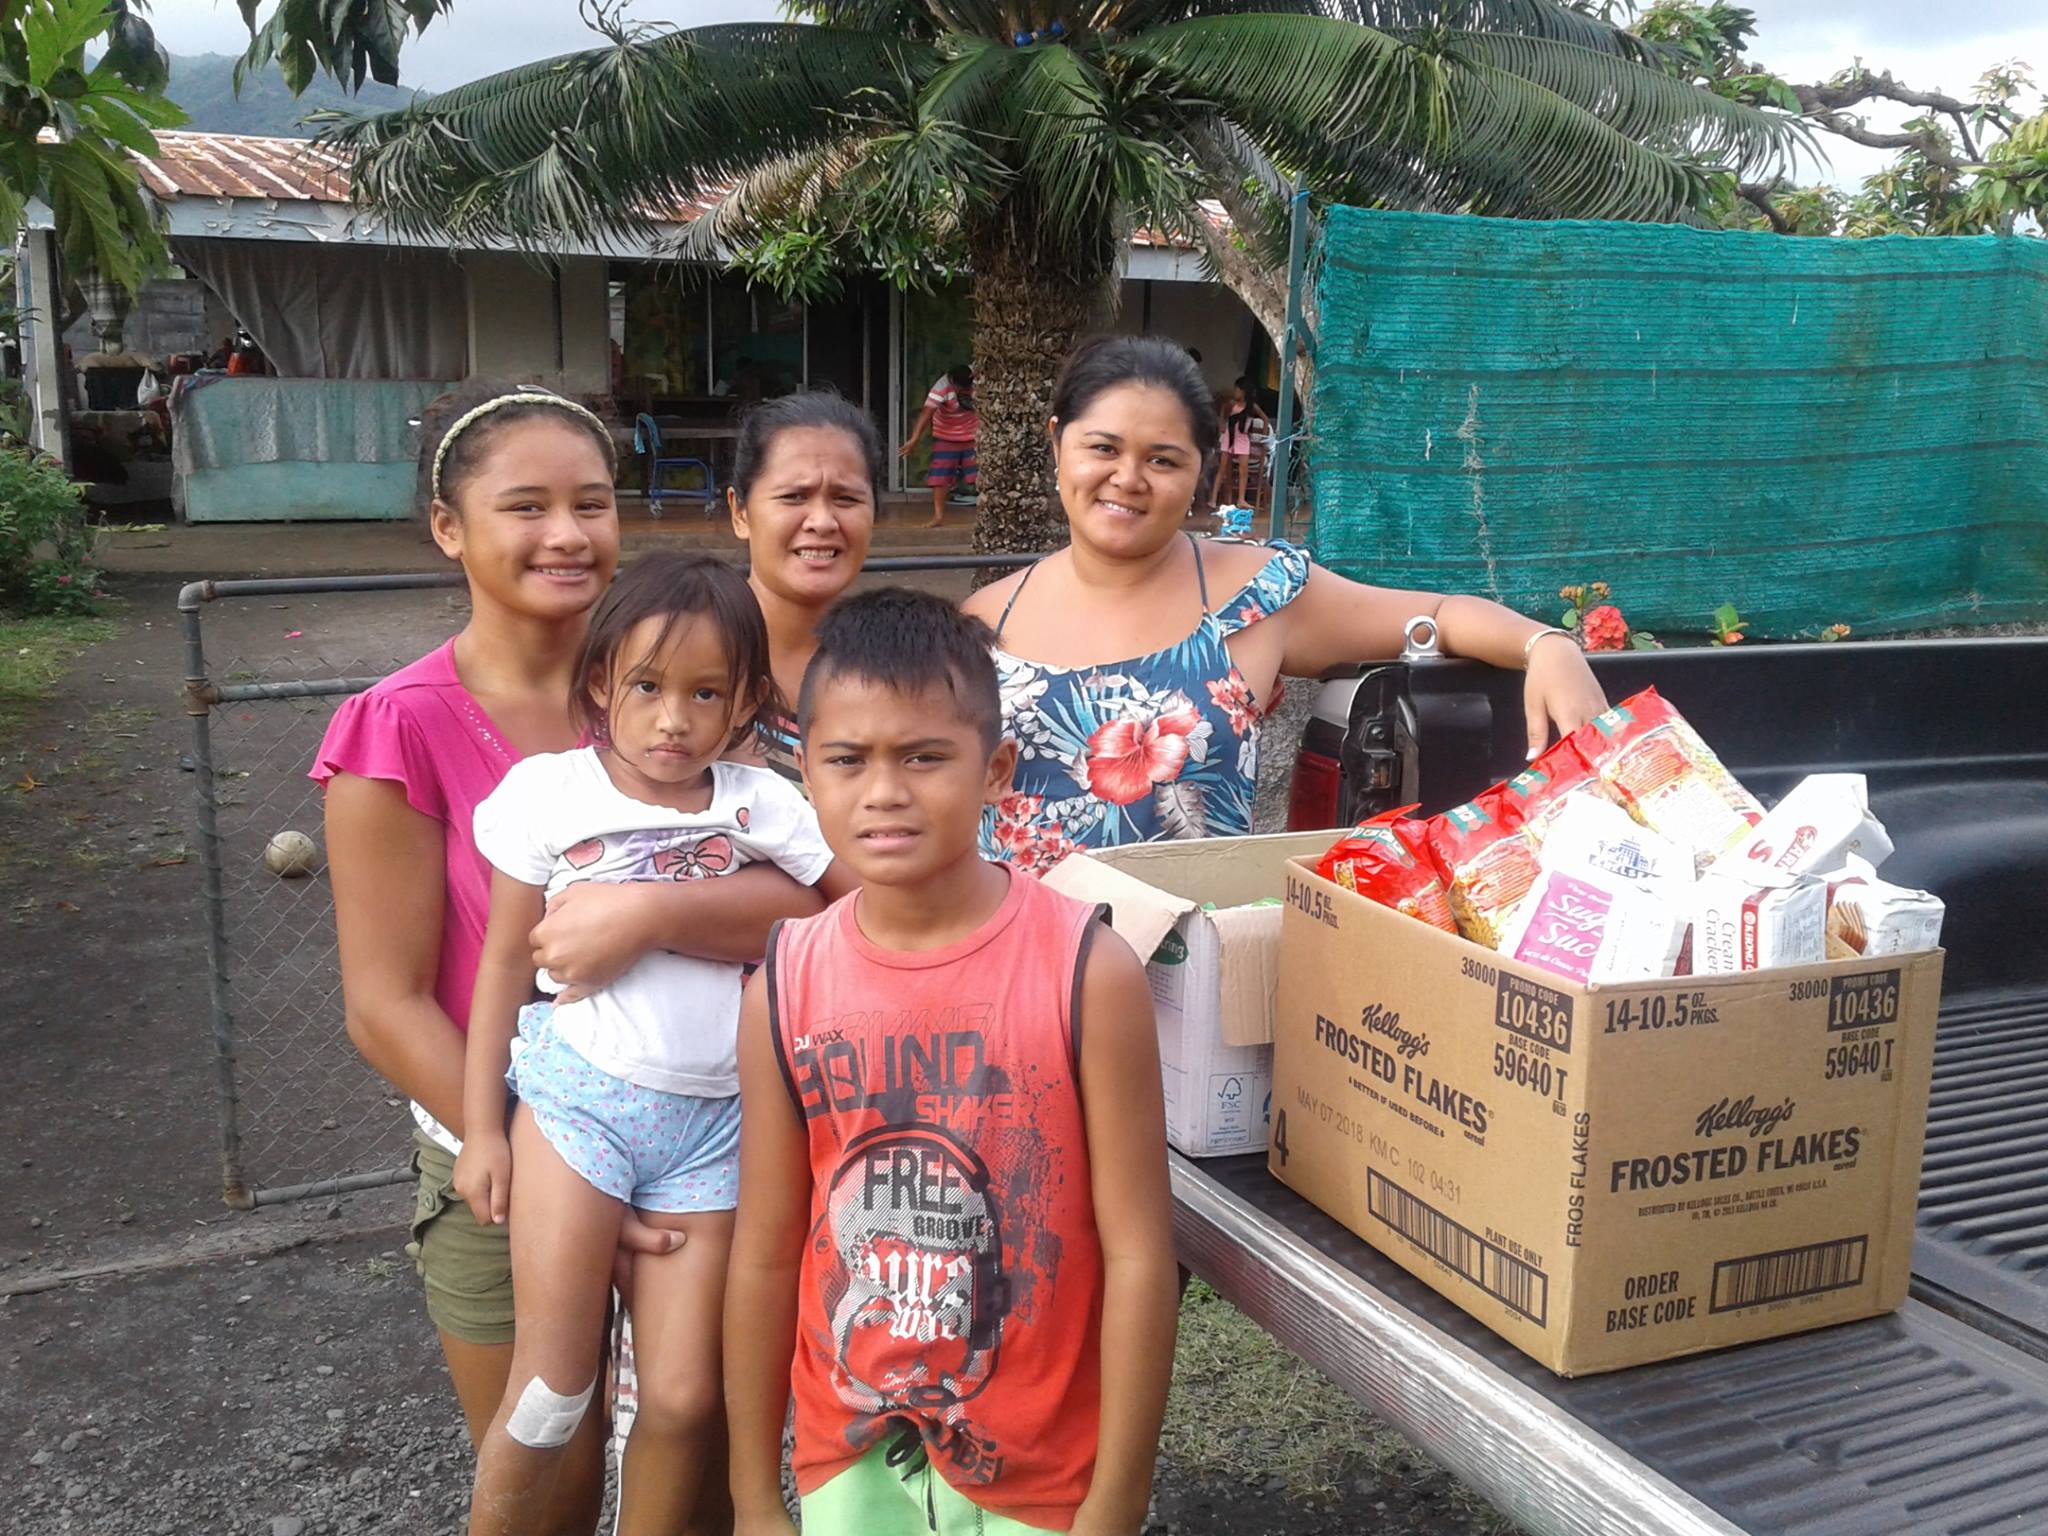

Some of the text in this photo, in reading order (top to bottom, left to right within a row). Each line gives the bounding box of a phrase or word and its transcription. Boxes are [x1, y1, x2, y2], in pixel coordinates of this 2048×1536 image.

[1286, 875, 1323, 920] 14-10.5
[1461, 957, 1497, 987] 38000
[1510, 978, 1560, 1006] PROMO CODE
[1788, 978, 1829, 1001] 38000
[1499, 990, 1568, 1045] 10436
[1604, 994, 1689, 1034] 14-10.5
[1832, 985, 1896, 1026] 10436
[812, 1028, 844, 1046] WAX
[1361, 1002, 1431, 1060] Kellogg's
[1508, 1033, 1551, 1061] BASE CODE
[1841, 1026, 1881, 1043] BASE CODE
[1315, 1013, 1397, 1085] FROSTED
[1403, 1063, 1488, 1134] FLAKES
[1493, 1041, 1552, 1097] 59640
[1824, 1040, 1881, 1081] 59640
[1273, 1108, 1290, 1168] 4
[1695, 1095, 1797, 1139] Kellogg's
[1319, 1106, 1333, 1124] 07
[1336, 1112, 1364, 1145] 2018
[1407, 1157, 1426, 1185] 102
[1609, 1126, 1862, 1194] FROSTED FLAKES
[863, 1147, 963, 1215] FREE
[1566, 1111, 1592, 1248] FROS FLAKES
[912, 1214, 987, 1241] GROOVE
[1485, 1225, 1544, 1269] PLANT USE ONLY
[1624, 1270, 1680, 1301] ORDER
[1605, 1296, 1697, 1334] BASE CODE
